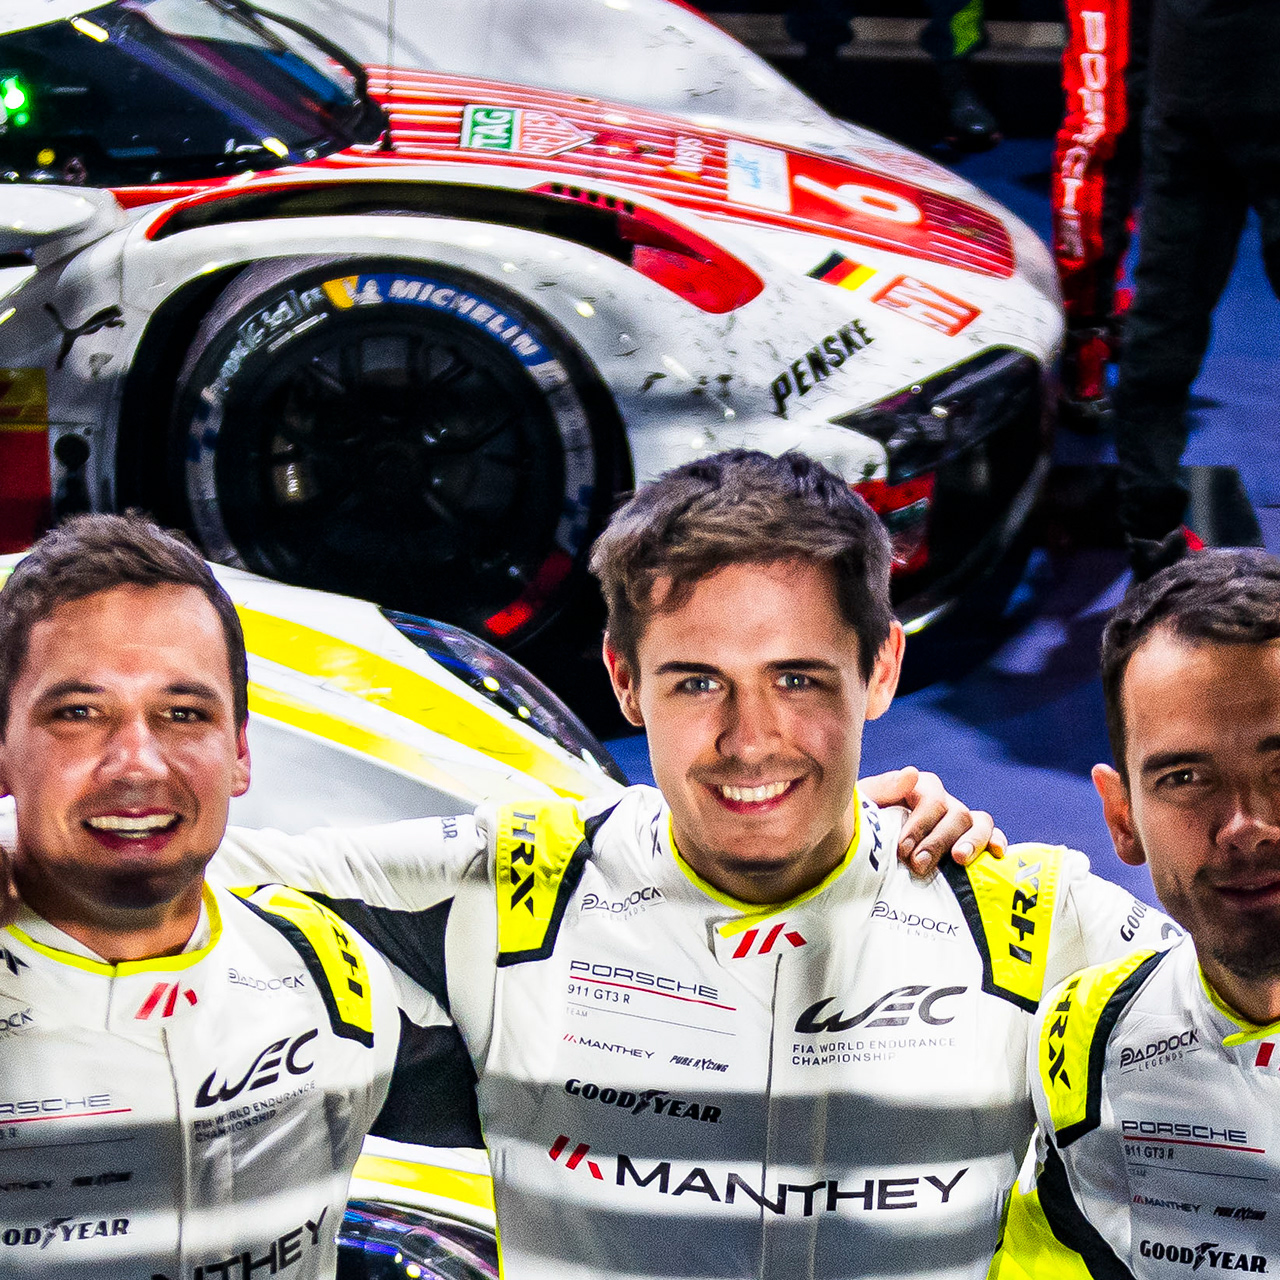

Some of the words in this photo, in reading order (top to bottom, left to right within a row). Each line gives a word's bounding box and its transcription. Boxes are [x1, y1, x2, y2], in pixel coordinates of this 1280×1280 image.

[472, 108, 513, 148] TAG
[388, 279, 540, 356] MICHELIN
[769, 319, 878, 417] PENSKE
[511, 811, 536, 917] HRX
[870, 900, 959, 937] PADDOCK
[1009, 858, 1042, 964] HRX
[567, 982, 590, 998] 911
[593, 987, 620, 1004] GT3
[622, 993, 631, 1005] R
[570, 960, 718, 1000] PORSCHE
[794, 985, 968, 1034] WEC
[579, 1036, 655, 1060] MANTHEY
[792, 1043, 815, 1055] FIA
[819, 1039, 865, 1053] WORLD
[870, 1036, 956, 1049] ENDURANCE
[1047, 977, 1081, 1091] HRX
[1120, 1029, 1200, 1068] PADDOCK
[196, 1028, 319, 1108] WEC
[669, 1053, 692, 1068] PURE
[792, 1052, 895, 1066] CHAMPIONSHIP
[1137, 1051, 1184, 1072] LEGENDS
[215, 1107, 250, 1130] WORLD
[251, 1081, 317, 1114] ENDURANCE
[194, 1110, 277, 1143] CHAMPIONSHIP
[1121, 1120, 1248, 1144] PORSCHE
[1124, 1144, 1141, 1158] 911
[1143, 1146, 1165, 1160] GT3
[617, 1154, 970, 1218] MANTHEY
[1144, 1196, 1201, 1214] MANTHEY
